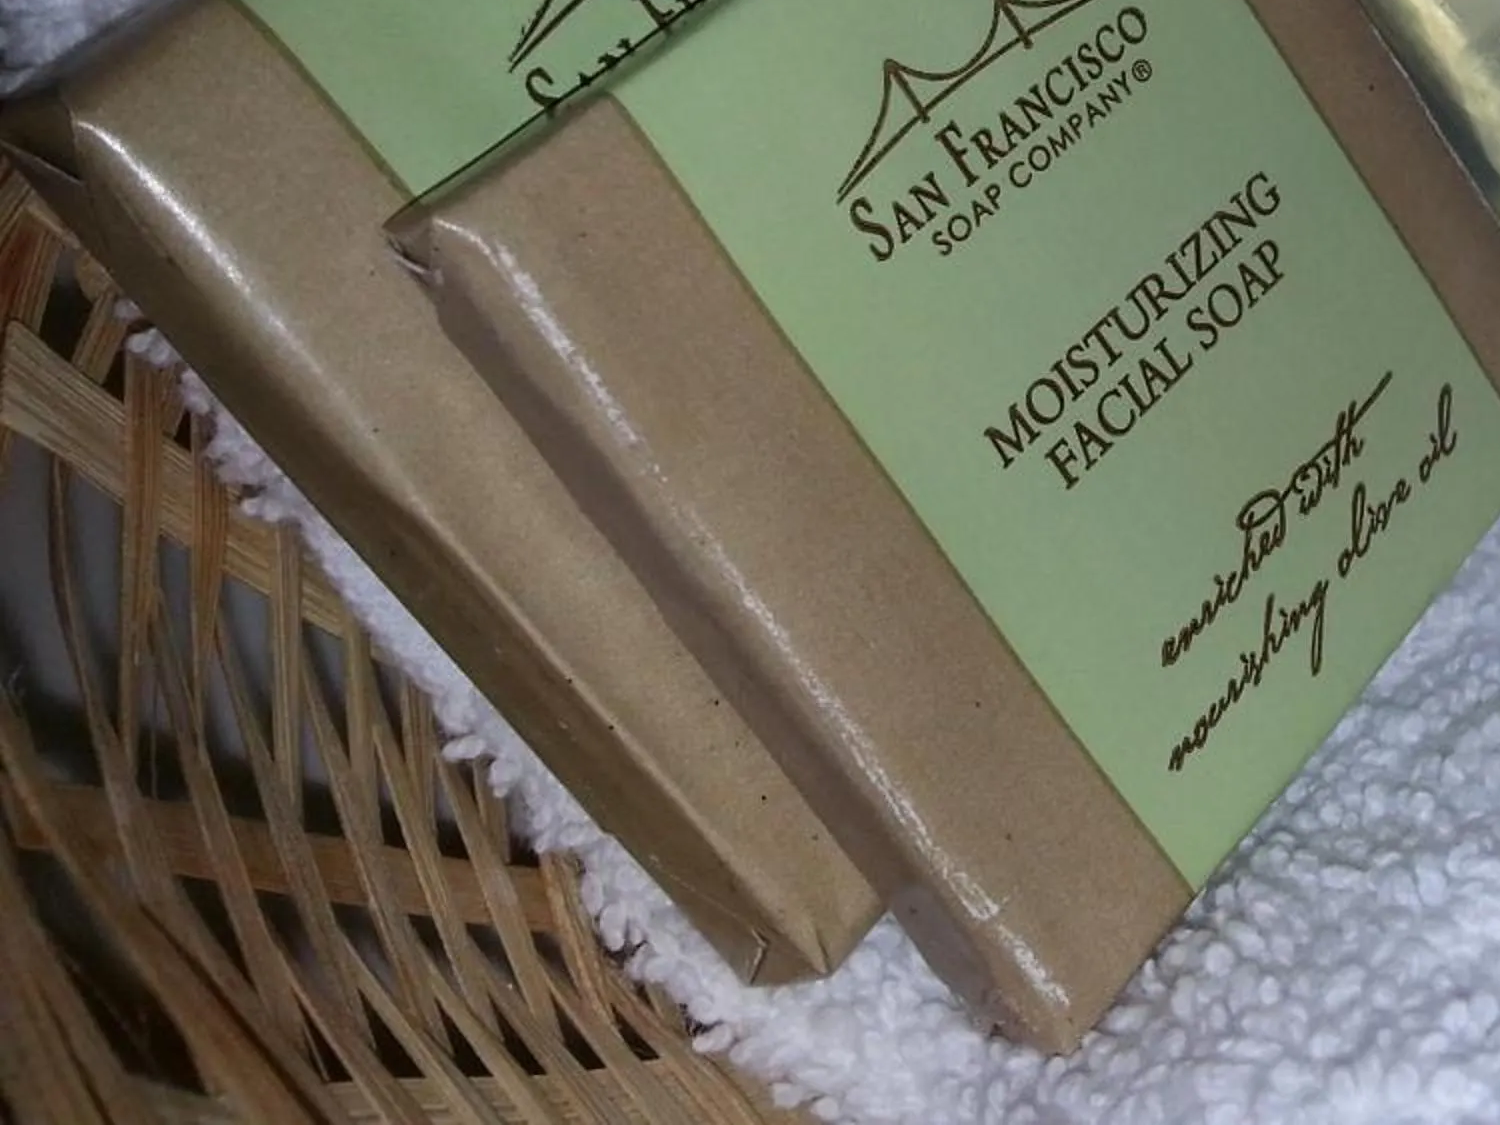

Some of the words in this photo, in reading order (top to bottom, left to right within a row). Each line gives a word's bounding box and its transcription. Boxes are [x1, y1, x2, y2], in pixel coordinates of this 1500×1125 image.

[850, 171, 951, 262] SAN
[935, 6, 1147, 187] FRANCISCO
[932, 183, 1001, 256] SOAP
[983, 172, 1280, 469] MOISTURIZING
[1044, 337, 1193, 490] FACIAL
[1186, 239, 1284, 351] SOAP
[1161, 488, 1286, 667] enriched
[1292, 371, 1392, 515] with
[1168, 579, 1329, 771] nourishing
[1338, 482, 1411, 578] olive
[1419, 383, 1457, 482] oil
